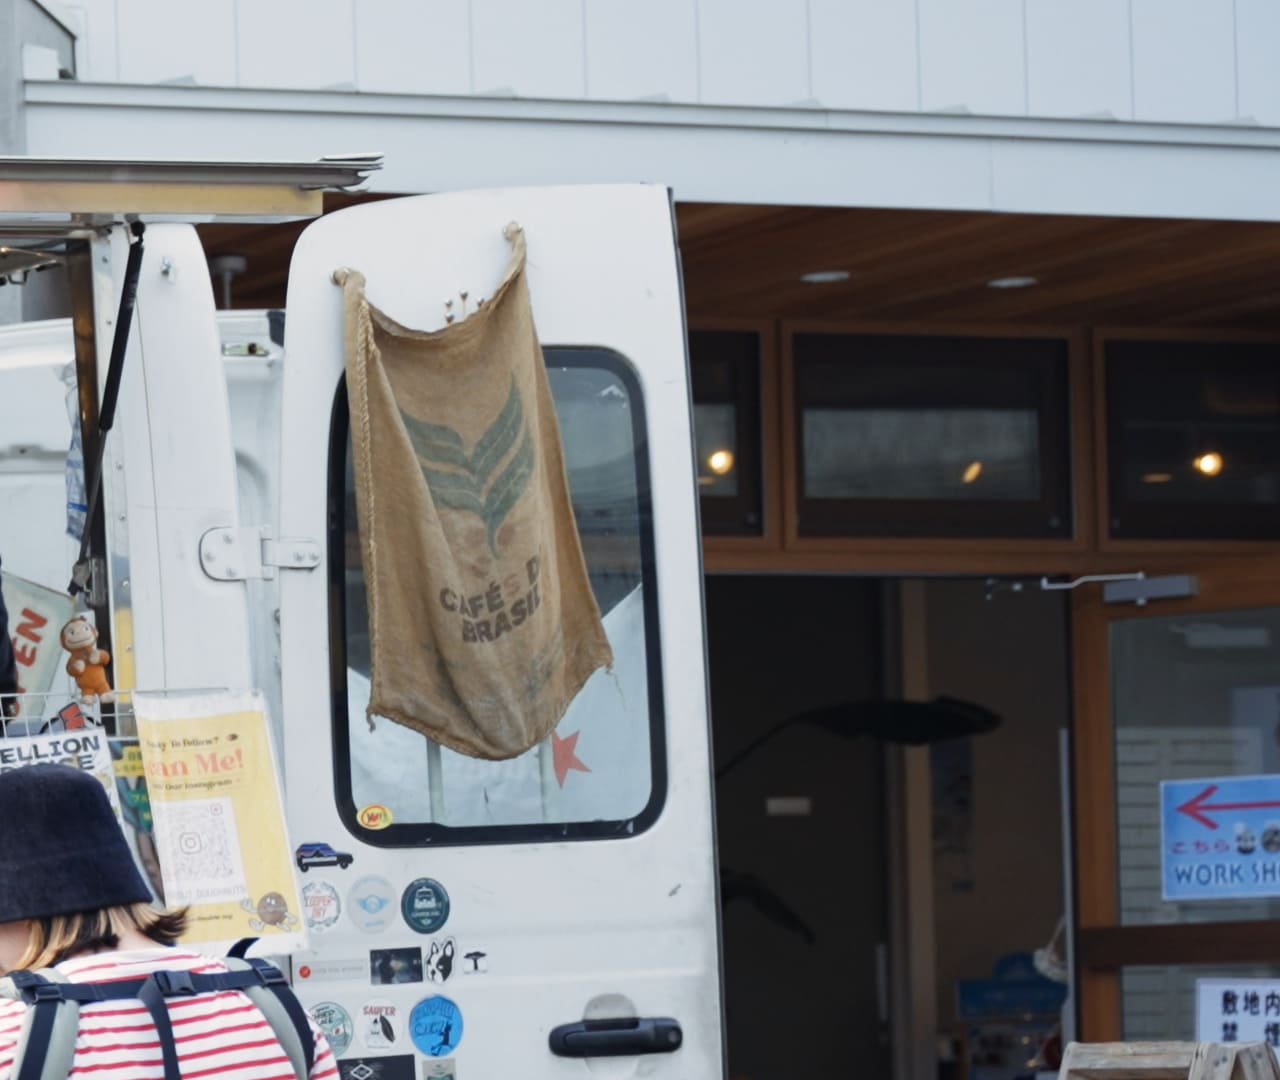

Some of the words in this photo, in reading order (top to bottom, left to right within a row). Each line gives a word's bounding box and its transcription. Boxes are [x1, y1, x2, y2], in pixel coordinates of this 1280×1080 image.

[195, 749, 244, 774] Me!
[1171, 840, 1230, 855] こちら
[1175, 864, 1244, 885] WORK
